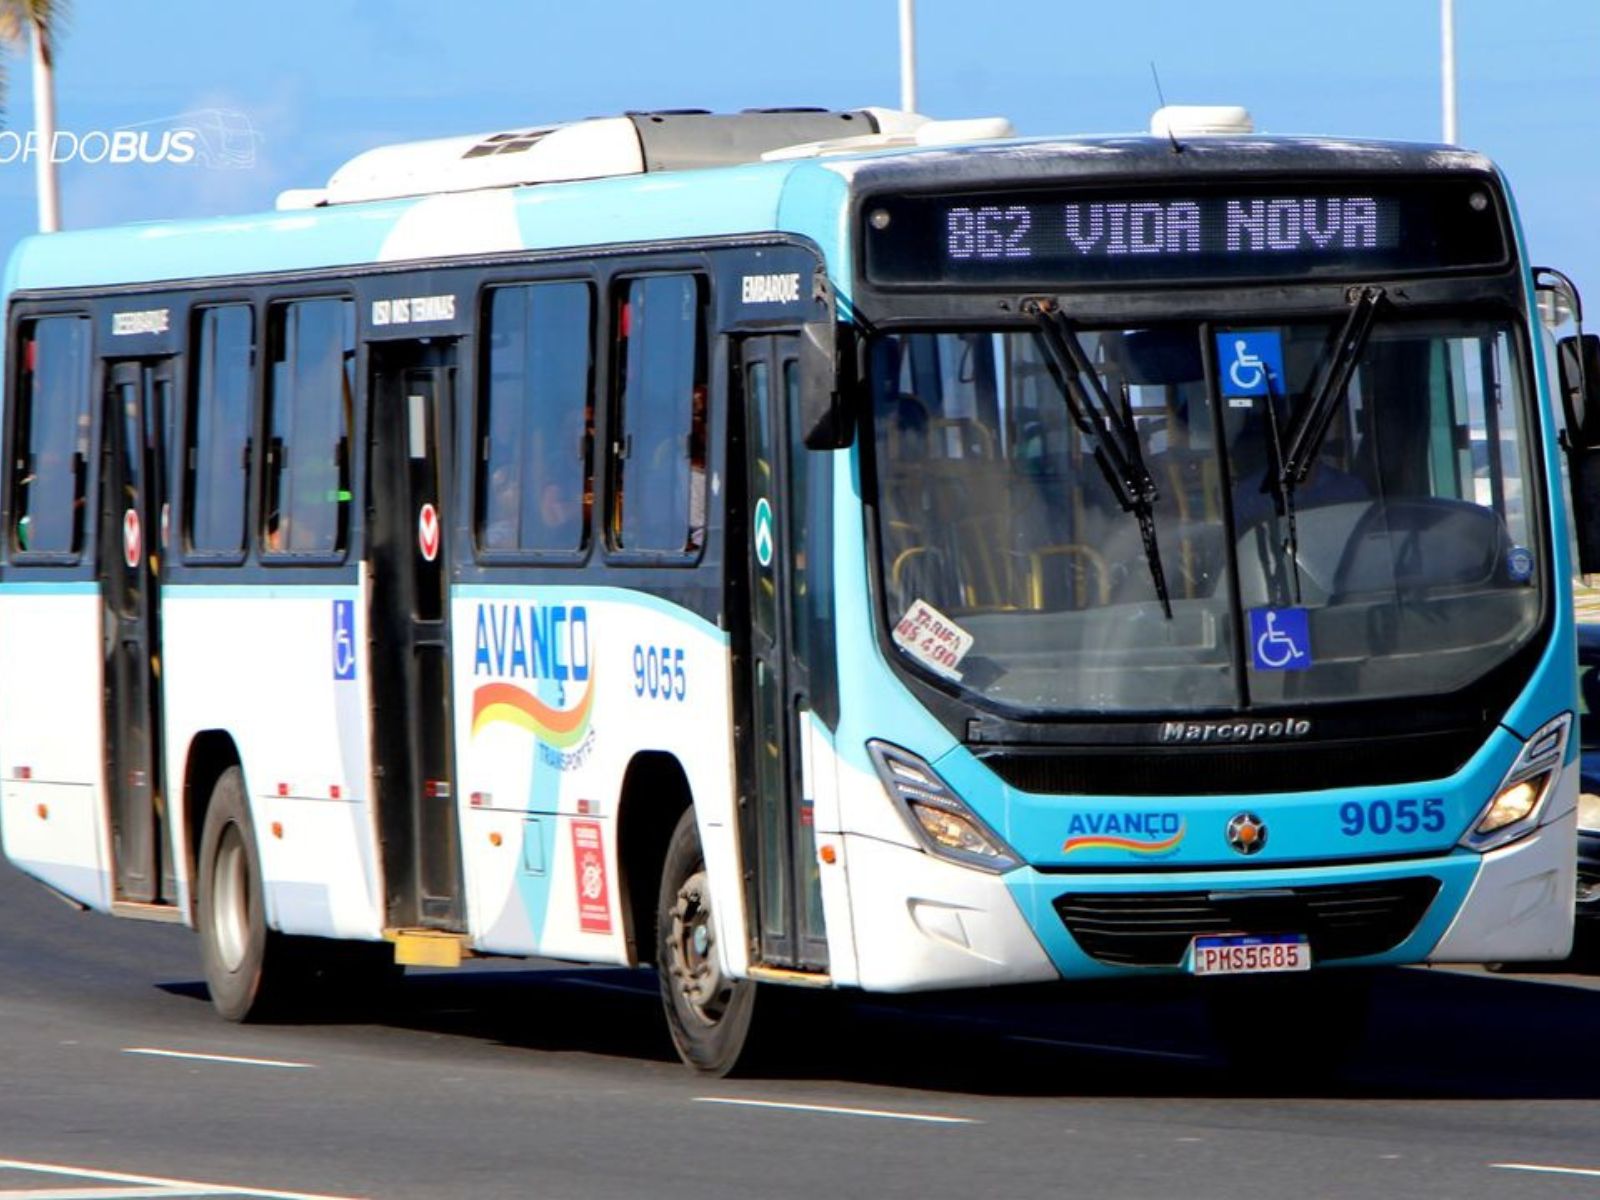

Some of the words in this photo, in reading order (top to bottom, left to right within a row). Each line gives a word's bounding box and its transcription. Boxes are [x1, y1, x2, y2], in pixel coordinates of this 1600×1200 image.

[948, 206, 1031, 258] 862
[1066, 203, 1200, 255] VIDA
[1227, 197, 1377, 251] NOVA
[742, 273, 799, 304] EMBARQUE
[916, 607, 961, 651] TARIFA
[474, 603, 589, 707] AVANÇO
[633, 644, 687, 702] 9055
[1163, 717, 1311, 741] Marcopolo
[1067, 812, 1179, 839] AVANÇO
[1339, 798, 1446, 837] 9055
[1205, 945, 1299, 971] PMS5G85
